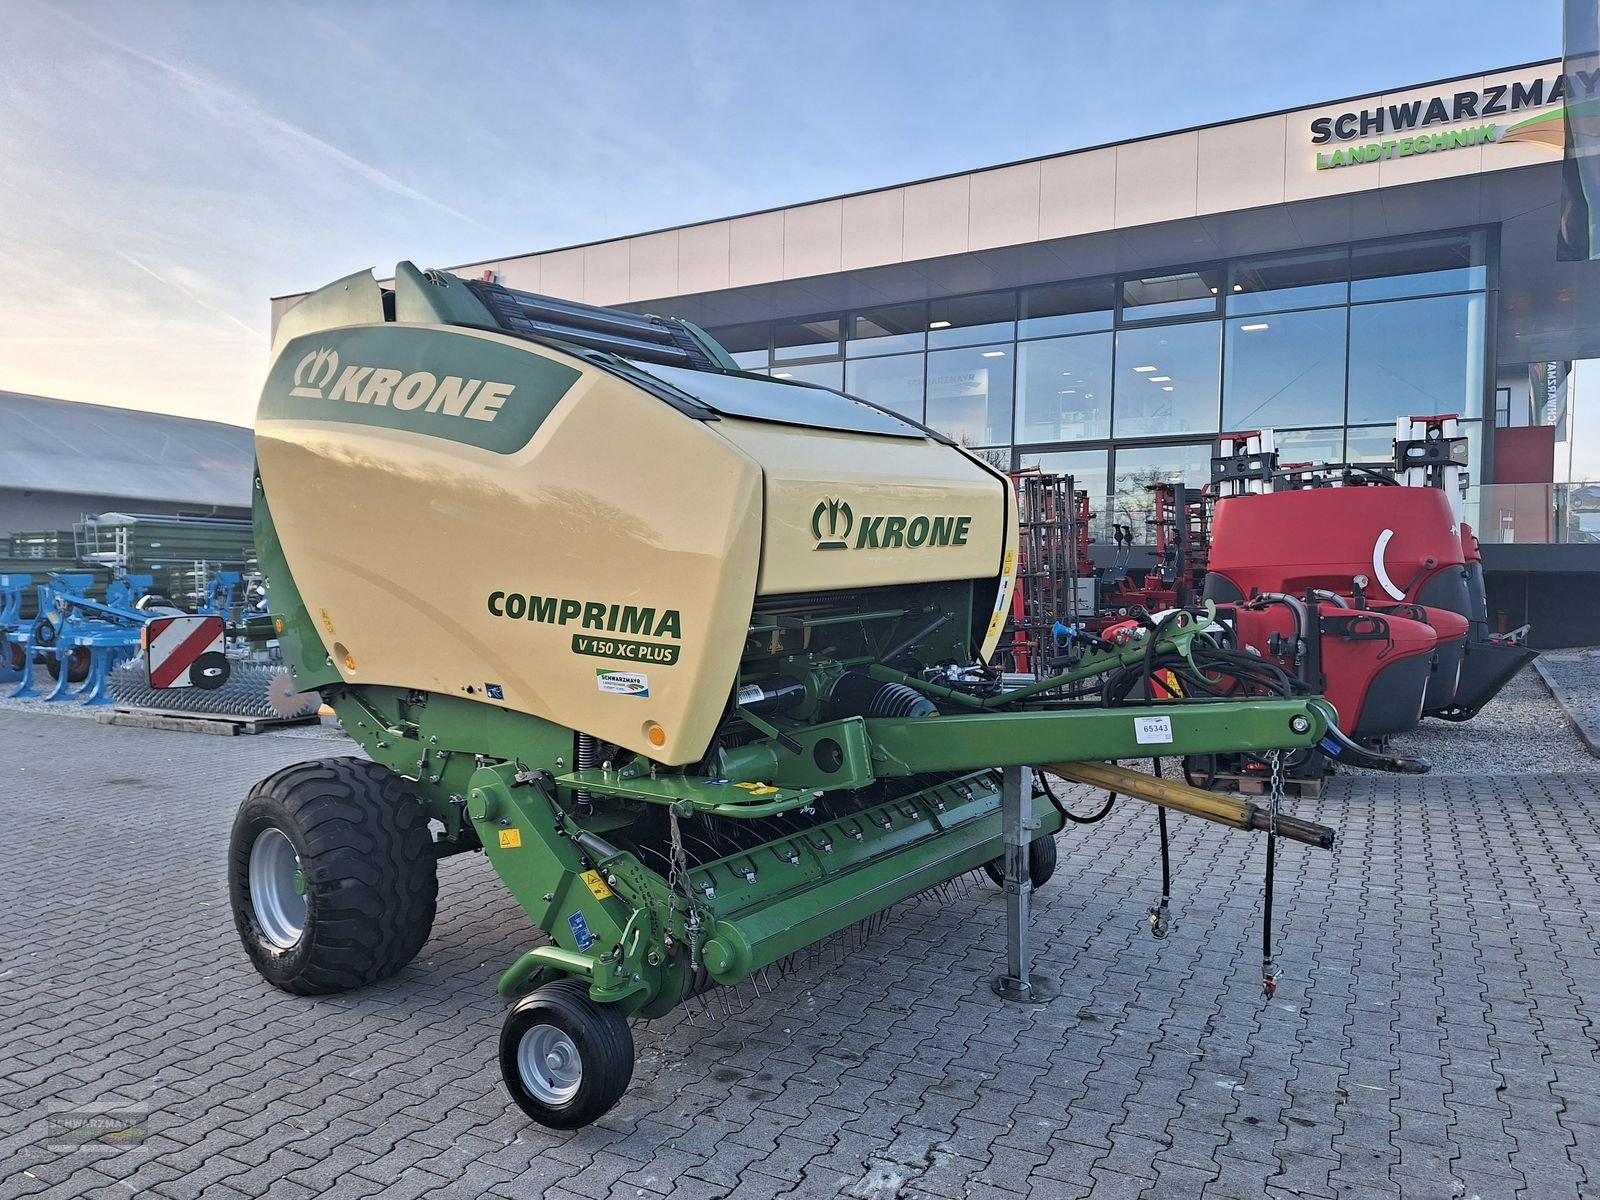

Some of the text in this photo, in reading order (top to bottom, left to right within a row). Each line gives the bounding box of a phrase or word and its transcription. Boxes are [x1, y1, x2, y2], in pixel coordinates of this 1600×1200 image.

[1316, 124, 1497, 170] LANDTECHNIK
[328, 366, 516, 422] KRONE
[856, 516, 972, 549] KRONE
[487, 591, 682, 639] COMPRIMA
[578, 639, 673, 662] V 150 XC PLUS
[601, 675, 641, 684] SCHWARZMAYR
[1144, 724, 1168, 733] 65343
